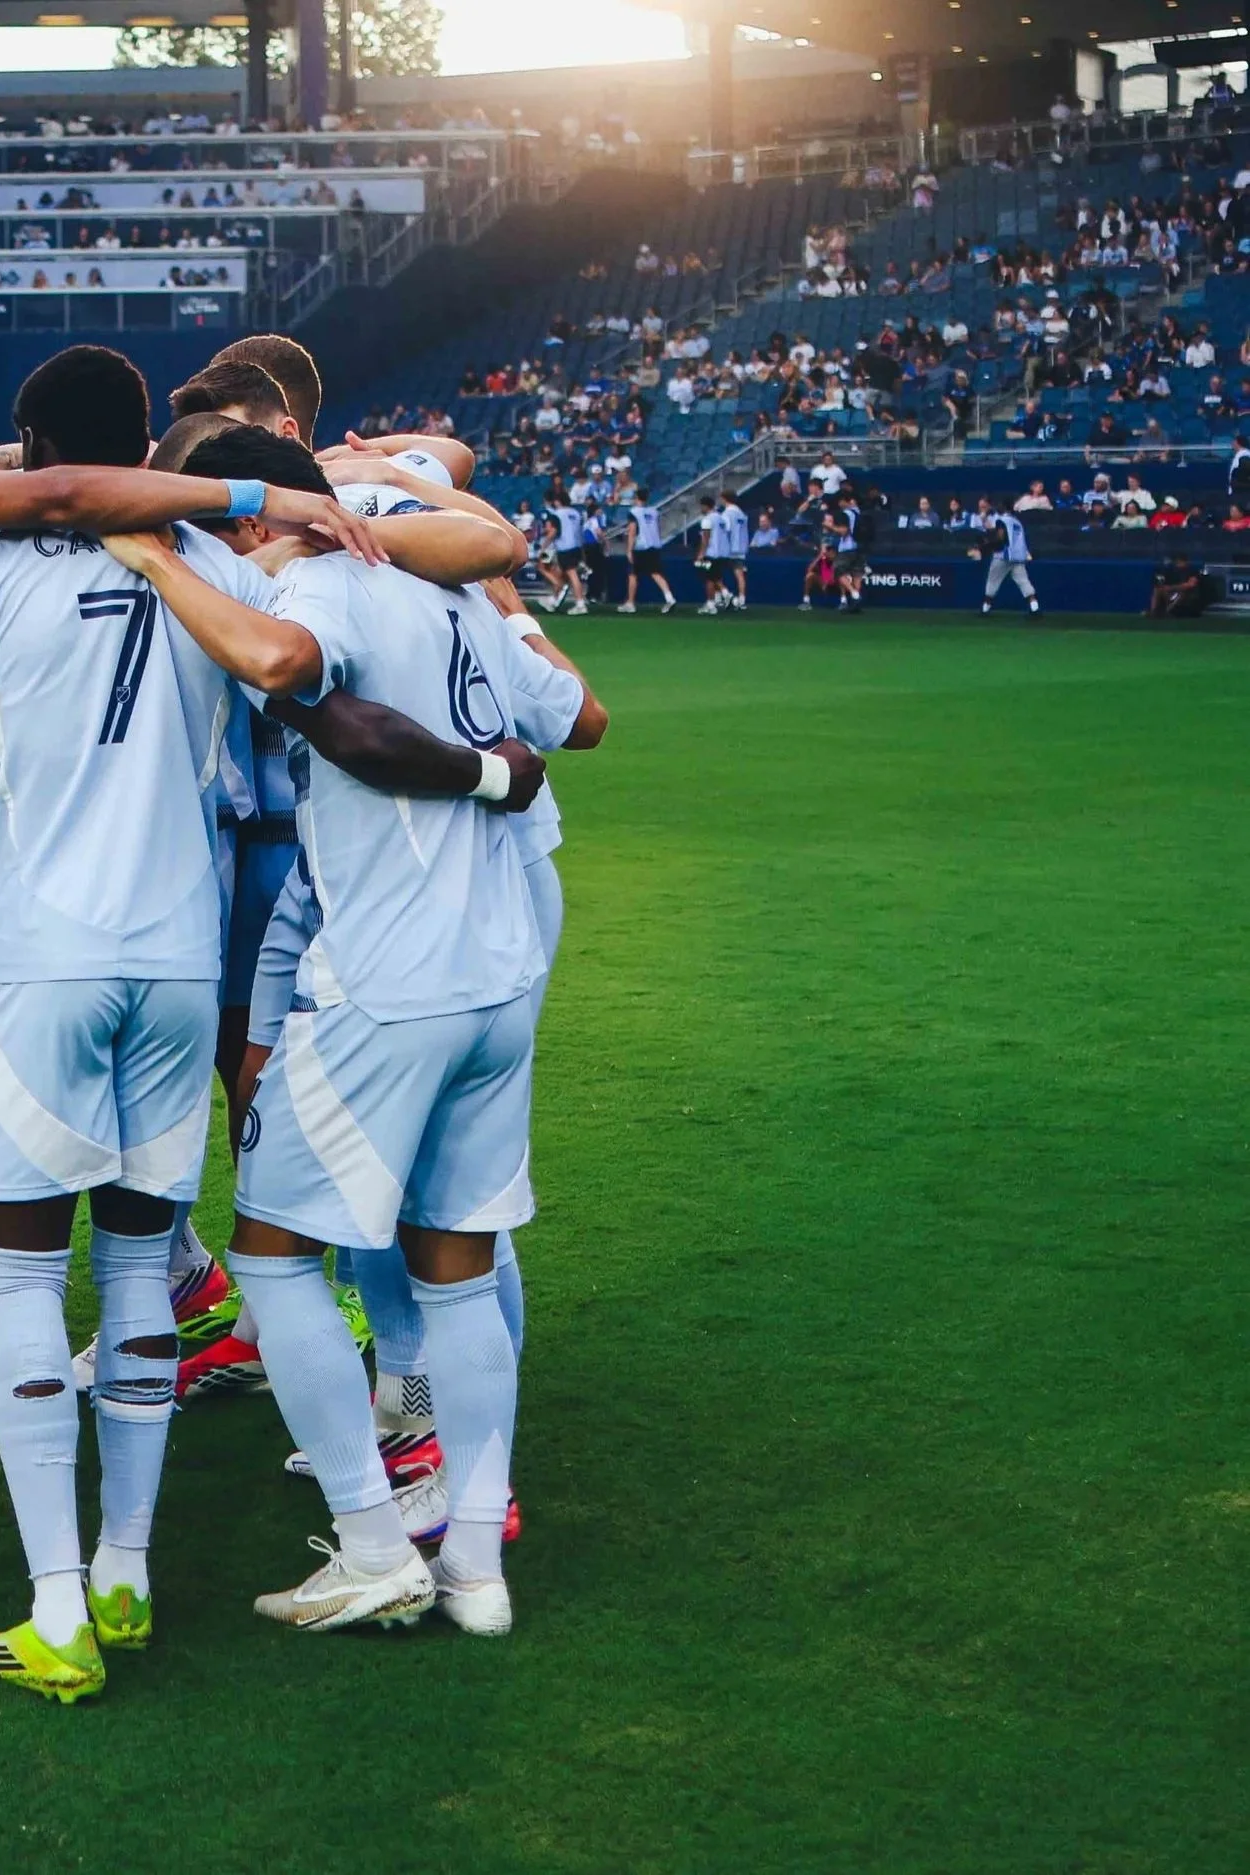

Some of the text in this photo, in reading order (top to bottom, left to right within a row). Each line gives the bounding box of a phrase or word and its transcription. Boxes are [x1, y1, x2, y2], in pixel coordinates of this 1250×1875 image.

[901, 575, 942, 587] PARK
[77, 588, 158, 745] 7
[446, 608, 506, 751] 6
